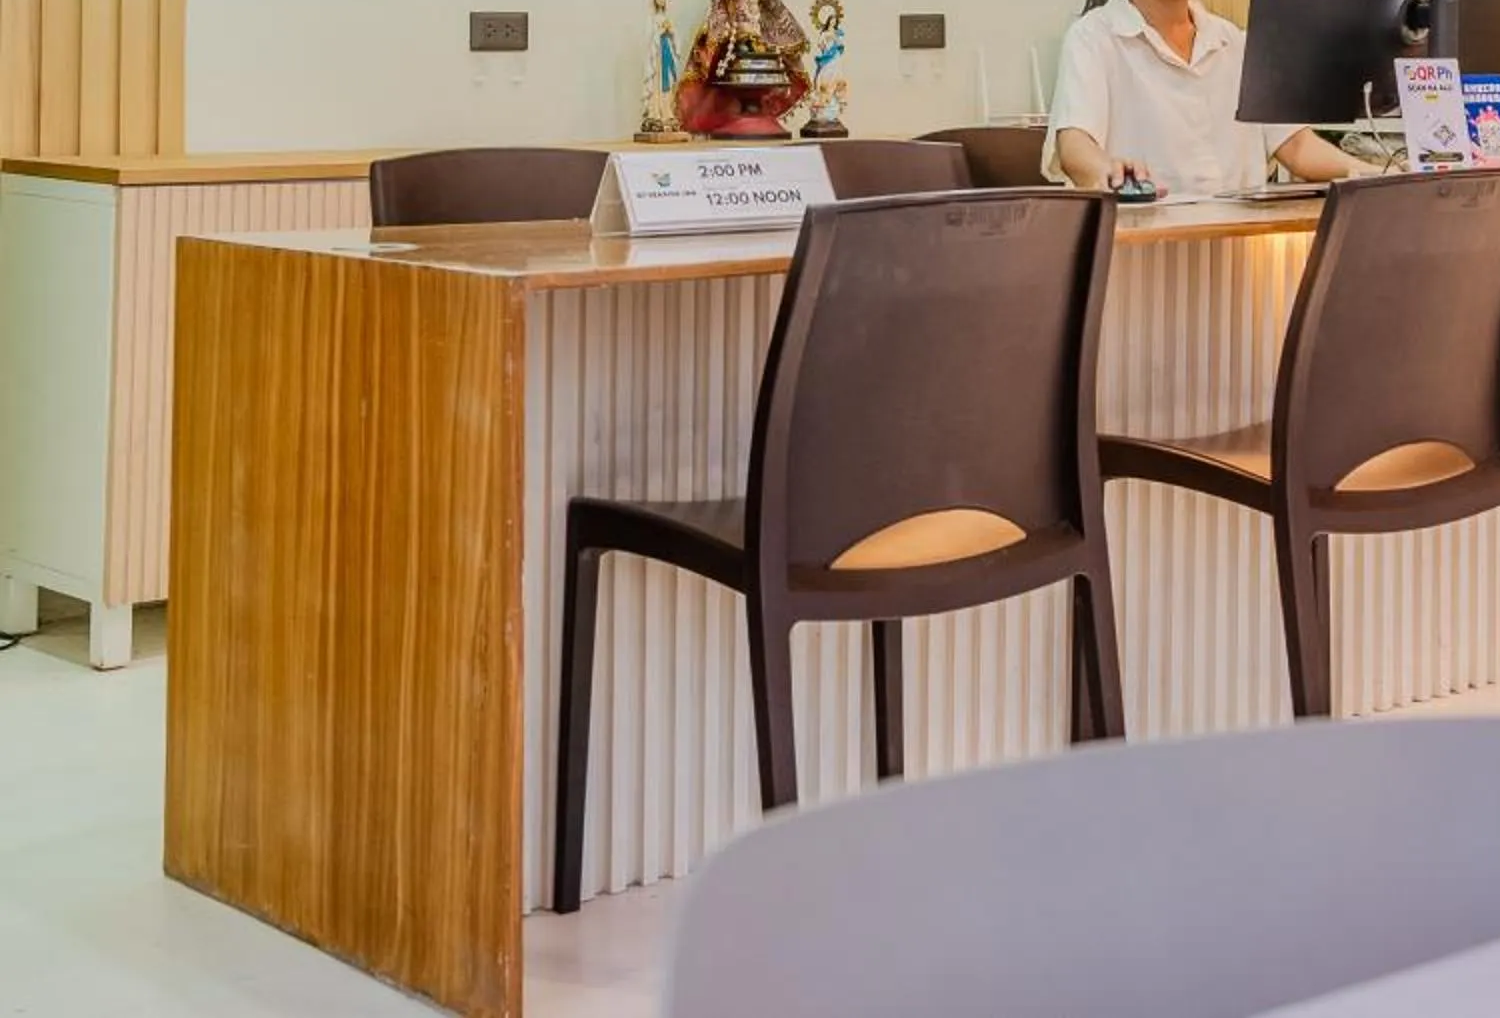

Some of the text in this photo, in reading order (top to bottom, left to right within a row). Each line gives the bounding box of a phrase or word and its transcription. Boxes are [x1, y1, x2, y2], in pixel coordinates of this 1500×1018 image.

[698, 162, 763, 178] 2:00 PM
[706, 192, 750, 206] 12:00
[752, 189, 802, 204] NOON
